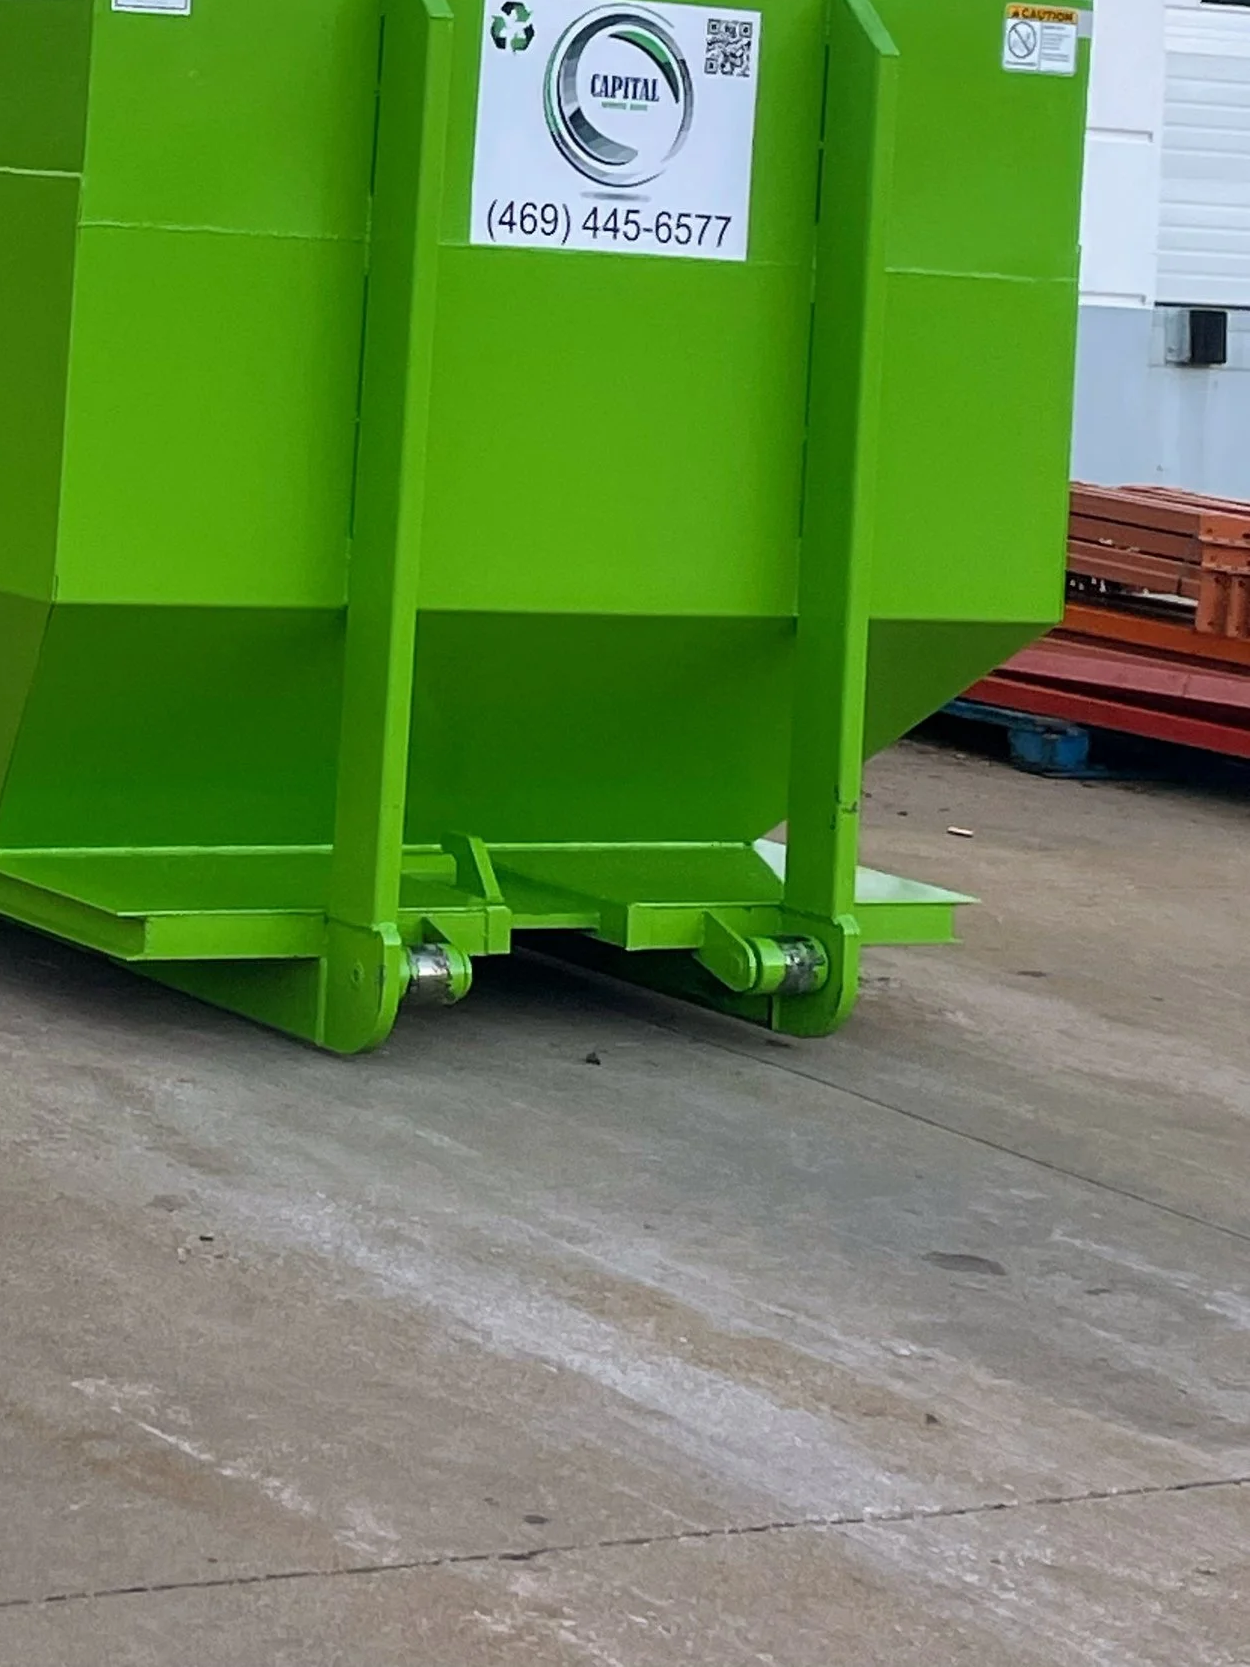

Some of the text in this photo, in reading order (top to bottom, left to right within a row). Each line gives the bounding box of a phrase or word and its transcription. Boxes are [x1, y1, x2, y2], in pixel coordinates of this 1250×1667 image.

[591, 73, 660, 102] CAPITAL
[487, 199, 732, 248] (469) 445-6577
